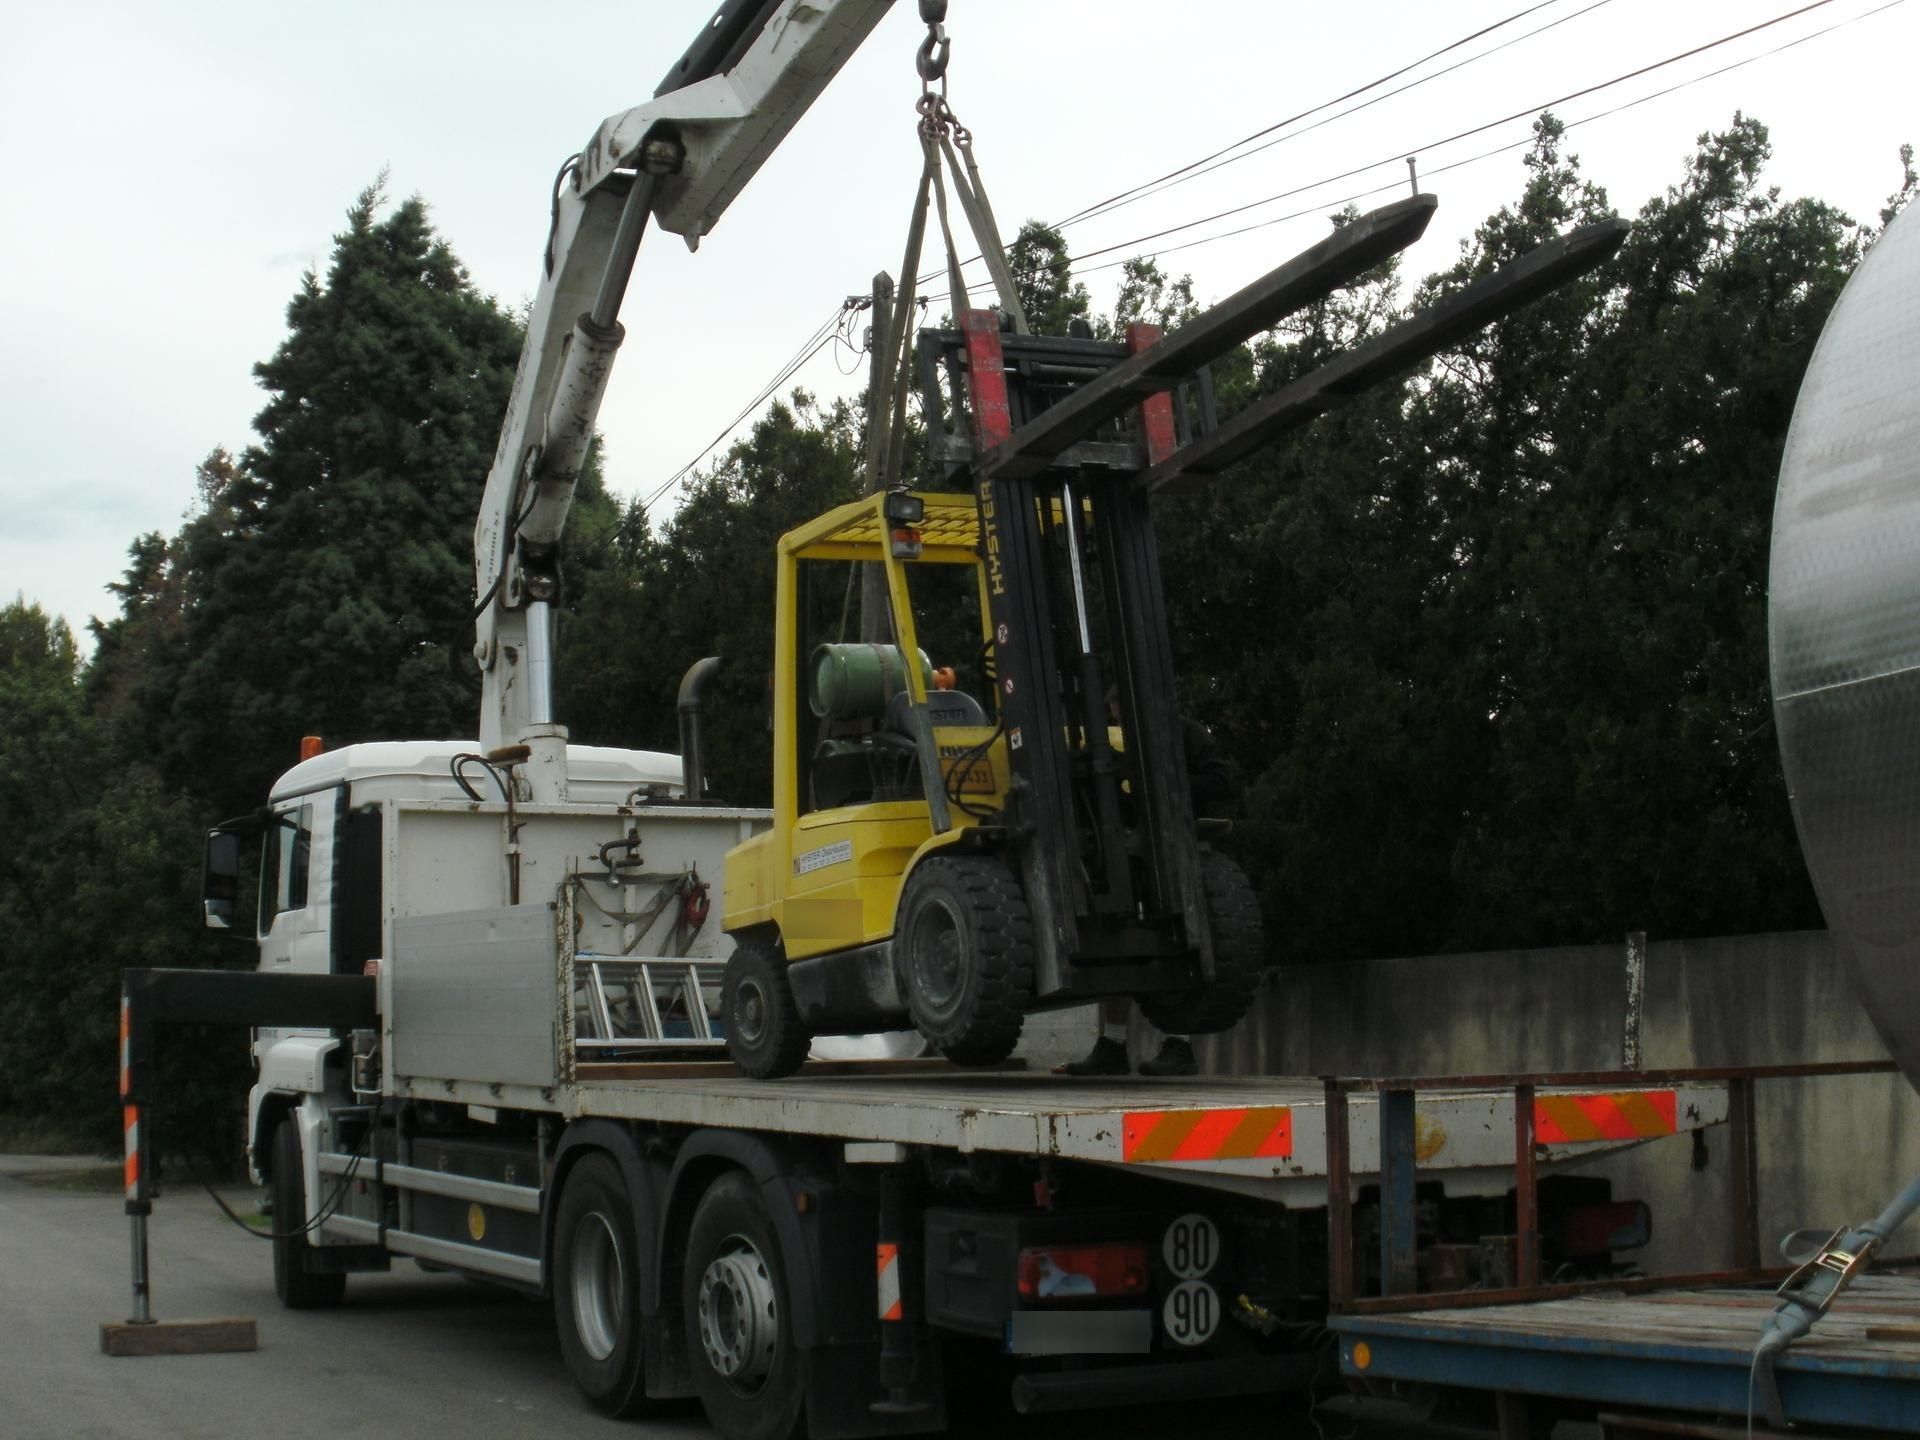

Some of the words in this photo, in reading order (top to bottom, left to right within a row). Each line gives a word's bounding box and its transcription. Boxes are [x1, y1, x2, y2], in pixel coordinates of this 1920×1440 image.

[980, 480, 1004, 595] HYSTER
[1173, 1221, 1210, 1272] 80
[1173, 1286, 1210, 1338] 90
